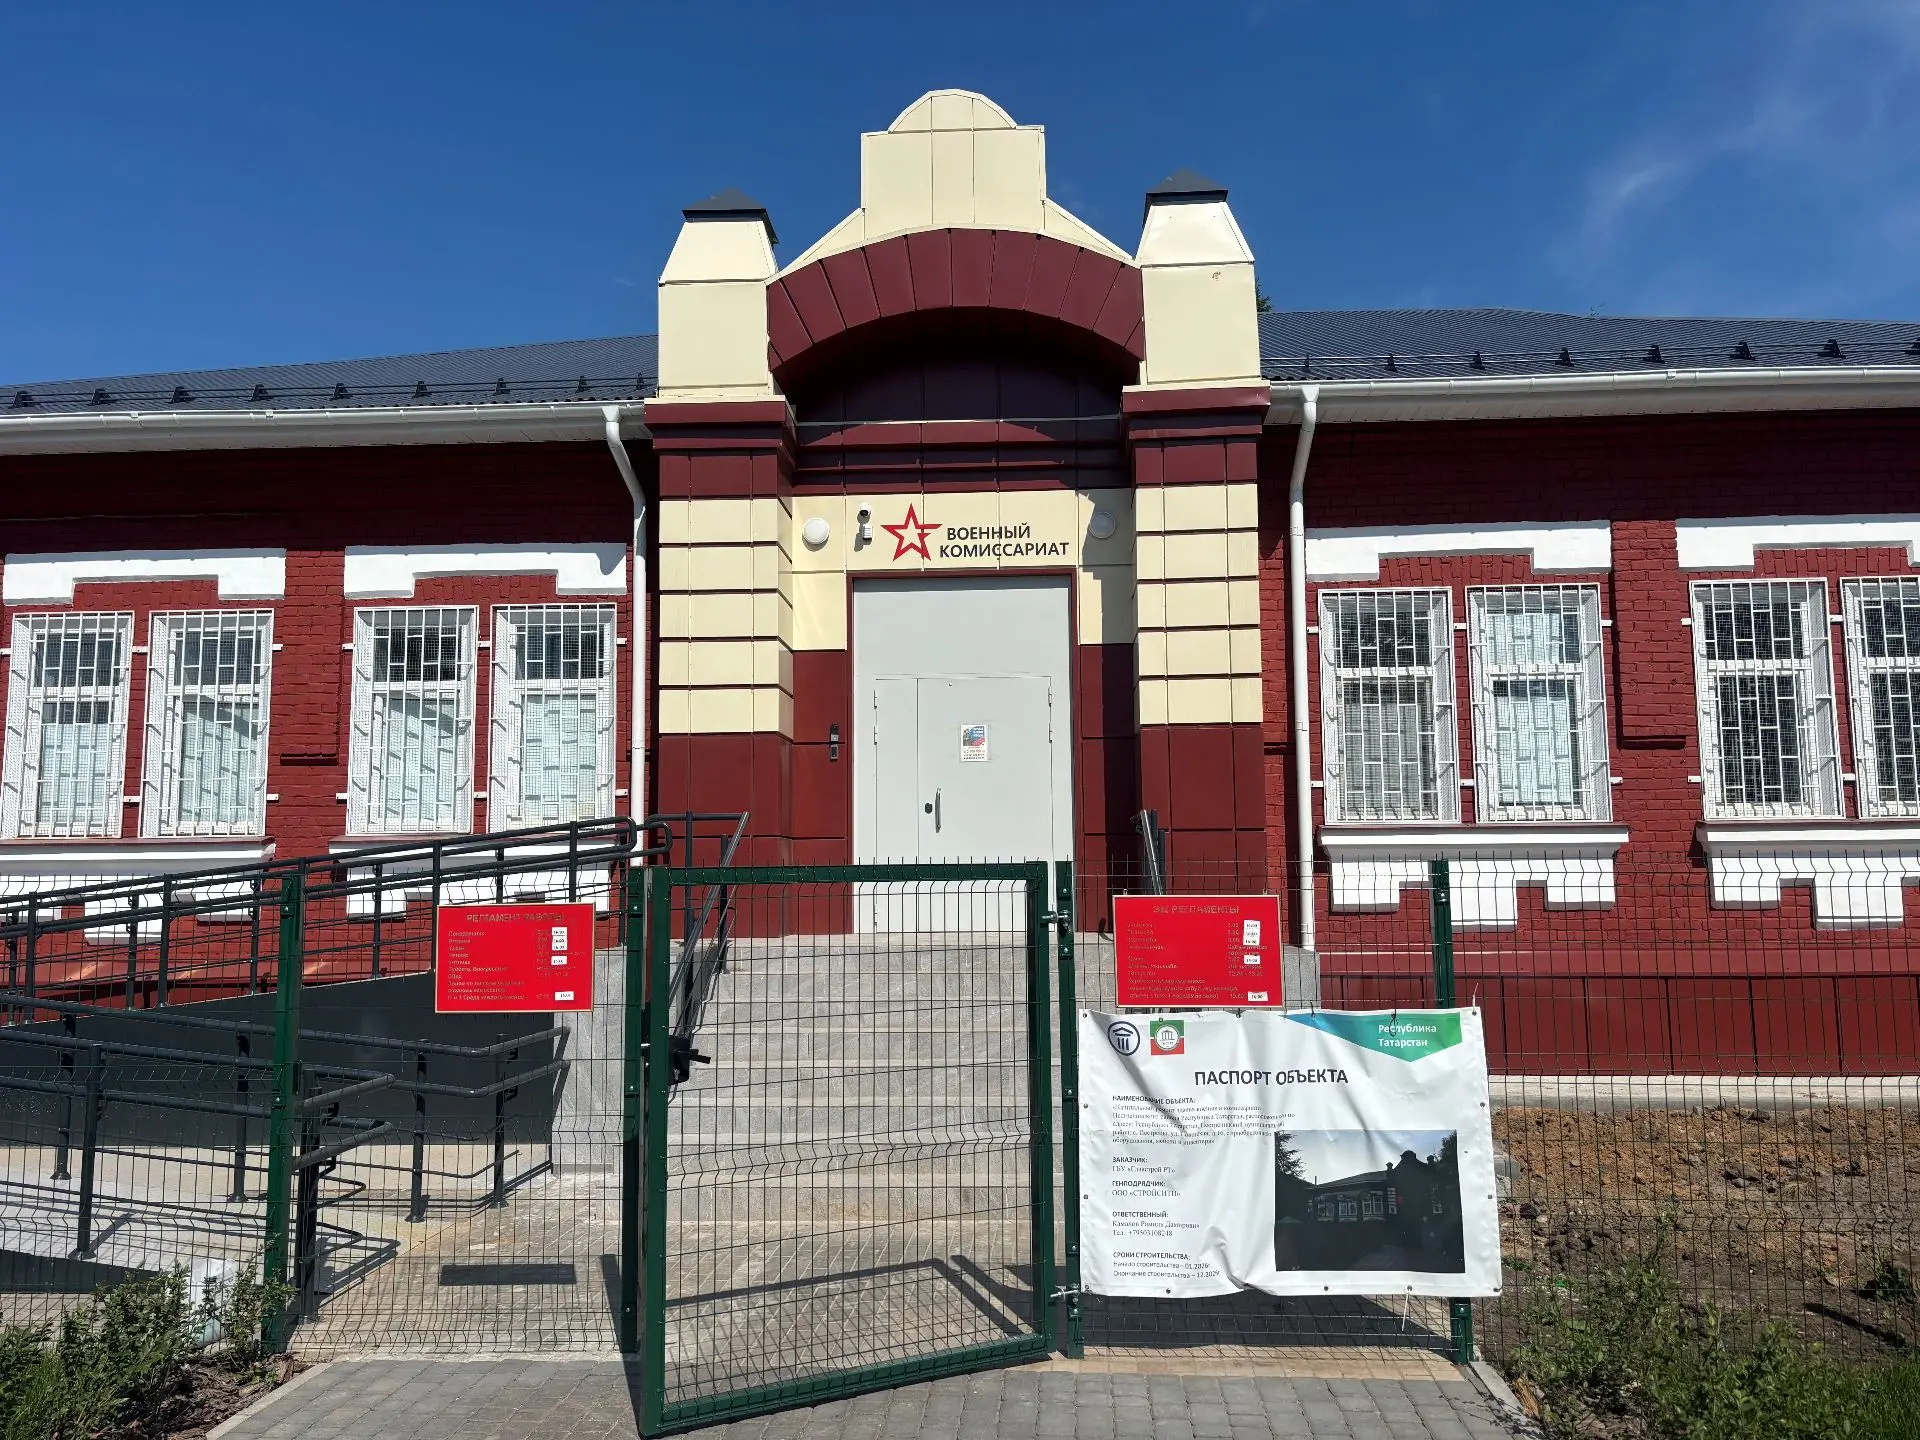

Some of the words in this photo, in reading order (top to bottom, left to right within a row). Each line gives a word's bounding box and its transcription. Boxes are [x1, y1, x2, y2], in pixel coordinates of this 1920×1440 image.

[947, 522, 1031, 540] ВОЕННЫЙ
[939, 542, 1070, 558] КОМИССАРИАТ
[1378, 1023, 1437, 1035] Республика
[1378, 1038, 1428, 1048] Татарстан
[1194, 1070, 1271, 1086] ПАСПОРТ
[1276, 1069, 1349, 1085] ОБЪЕКТА
[1112, 1095, 1164, 1105] НАИМЕНОВАНИЕ
[1165, 1097, 1196, 1105] ОБЪЕКТА:
[1112, 1180, 1166, 1188] ГЕНПОДРЯДЧИК:
[1112, 1189, 1128, 1197] ООО
[1112, 1210, 1169, 1218] ОТВЕТСТВЕННЫЙ:
[1135, 1251, 1191, 1260] СТРОИТЕЛЬСТВА:
